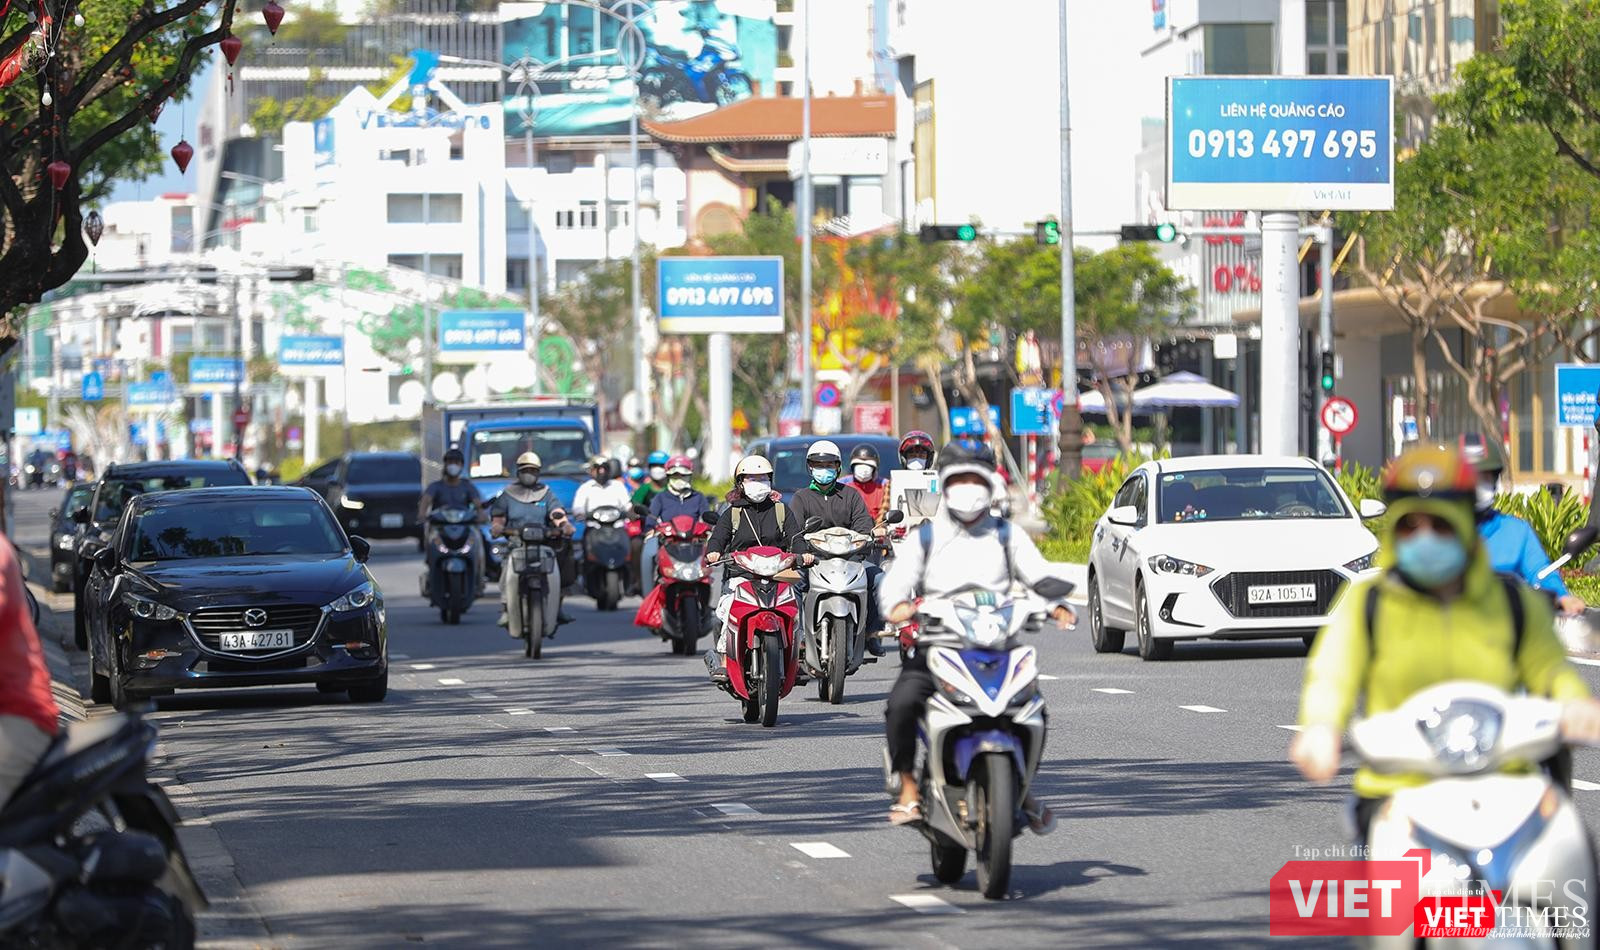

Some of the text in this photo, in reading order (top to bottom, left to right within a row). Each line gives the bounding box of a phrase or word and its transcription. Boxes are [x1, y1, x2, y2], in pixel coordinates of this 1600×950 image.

[1220, 101, 1345, 119] LIÊN HỆ QUẢNG CÁO
[1188, 129, 1376, 158] 0913 497 695
[1214, 264, 1261, 293] 0%
[666, 287, 774, 305] 0913 497 695
